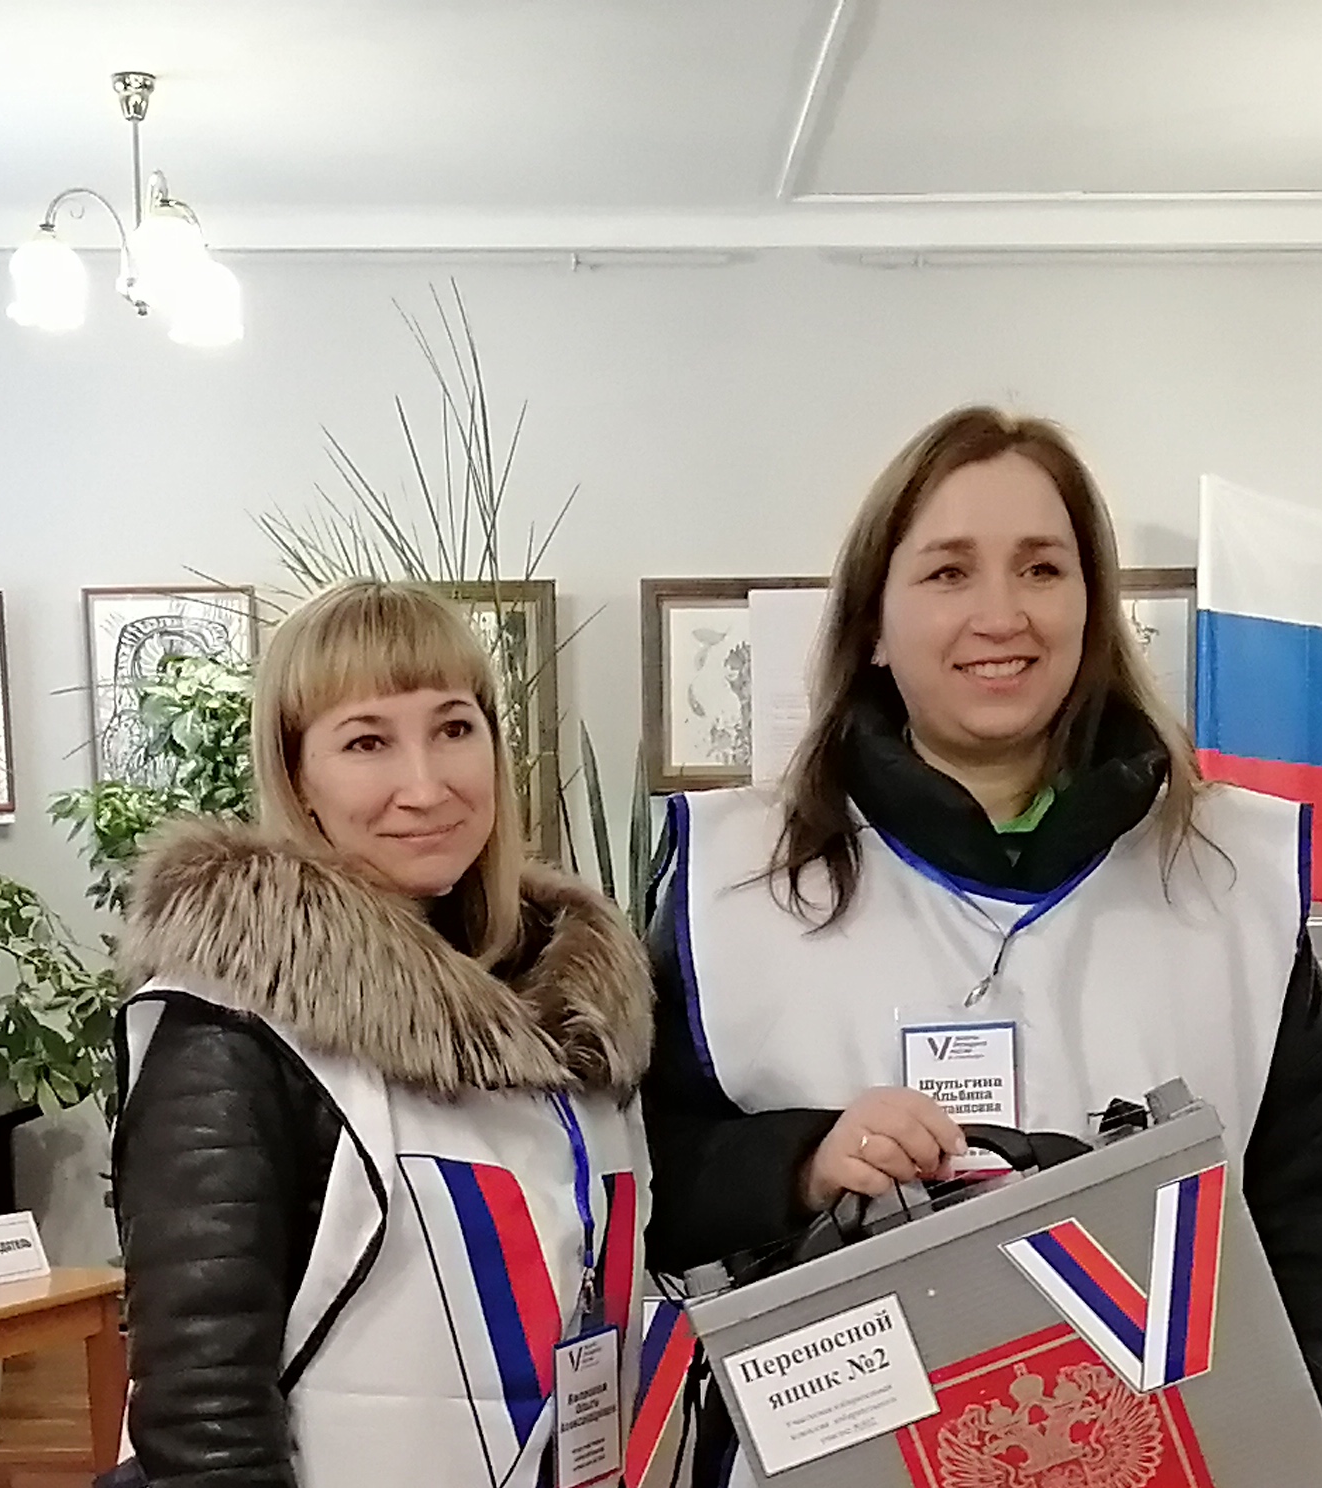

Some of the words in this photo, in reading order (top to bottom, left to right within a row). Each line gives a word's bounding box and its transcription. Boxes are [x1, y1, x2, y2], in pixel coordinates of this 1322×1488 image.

[919, 1078, 1003, 1094] Шульгина
[739, 1309, 894, 1384] Переносной
[768, 1370, 842, 1411] ящик
[847, 1348, 891, 1382] №2
